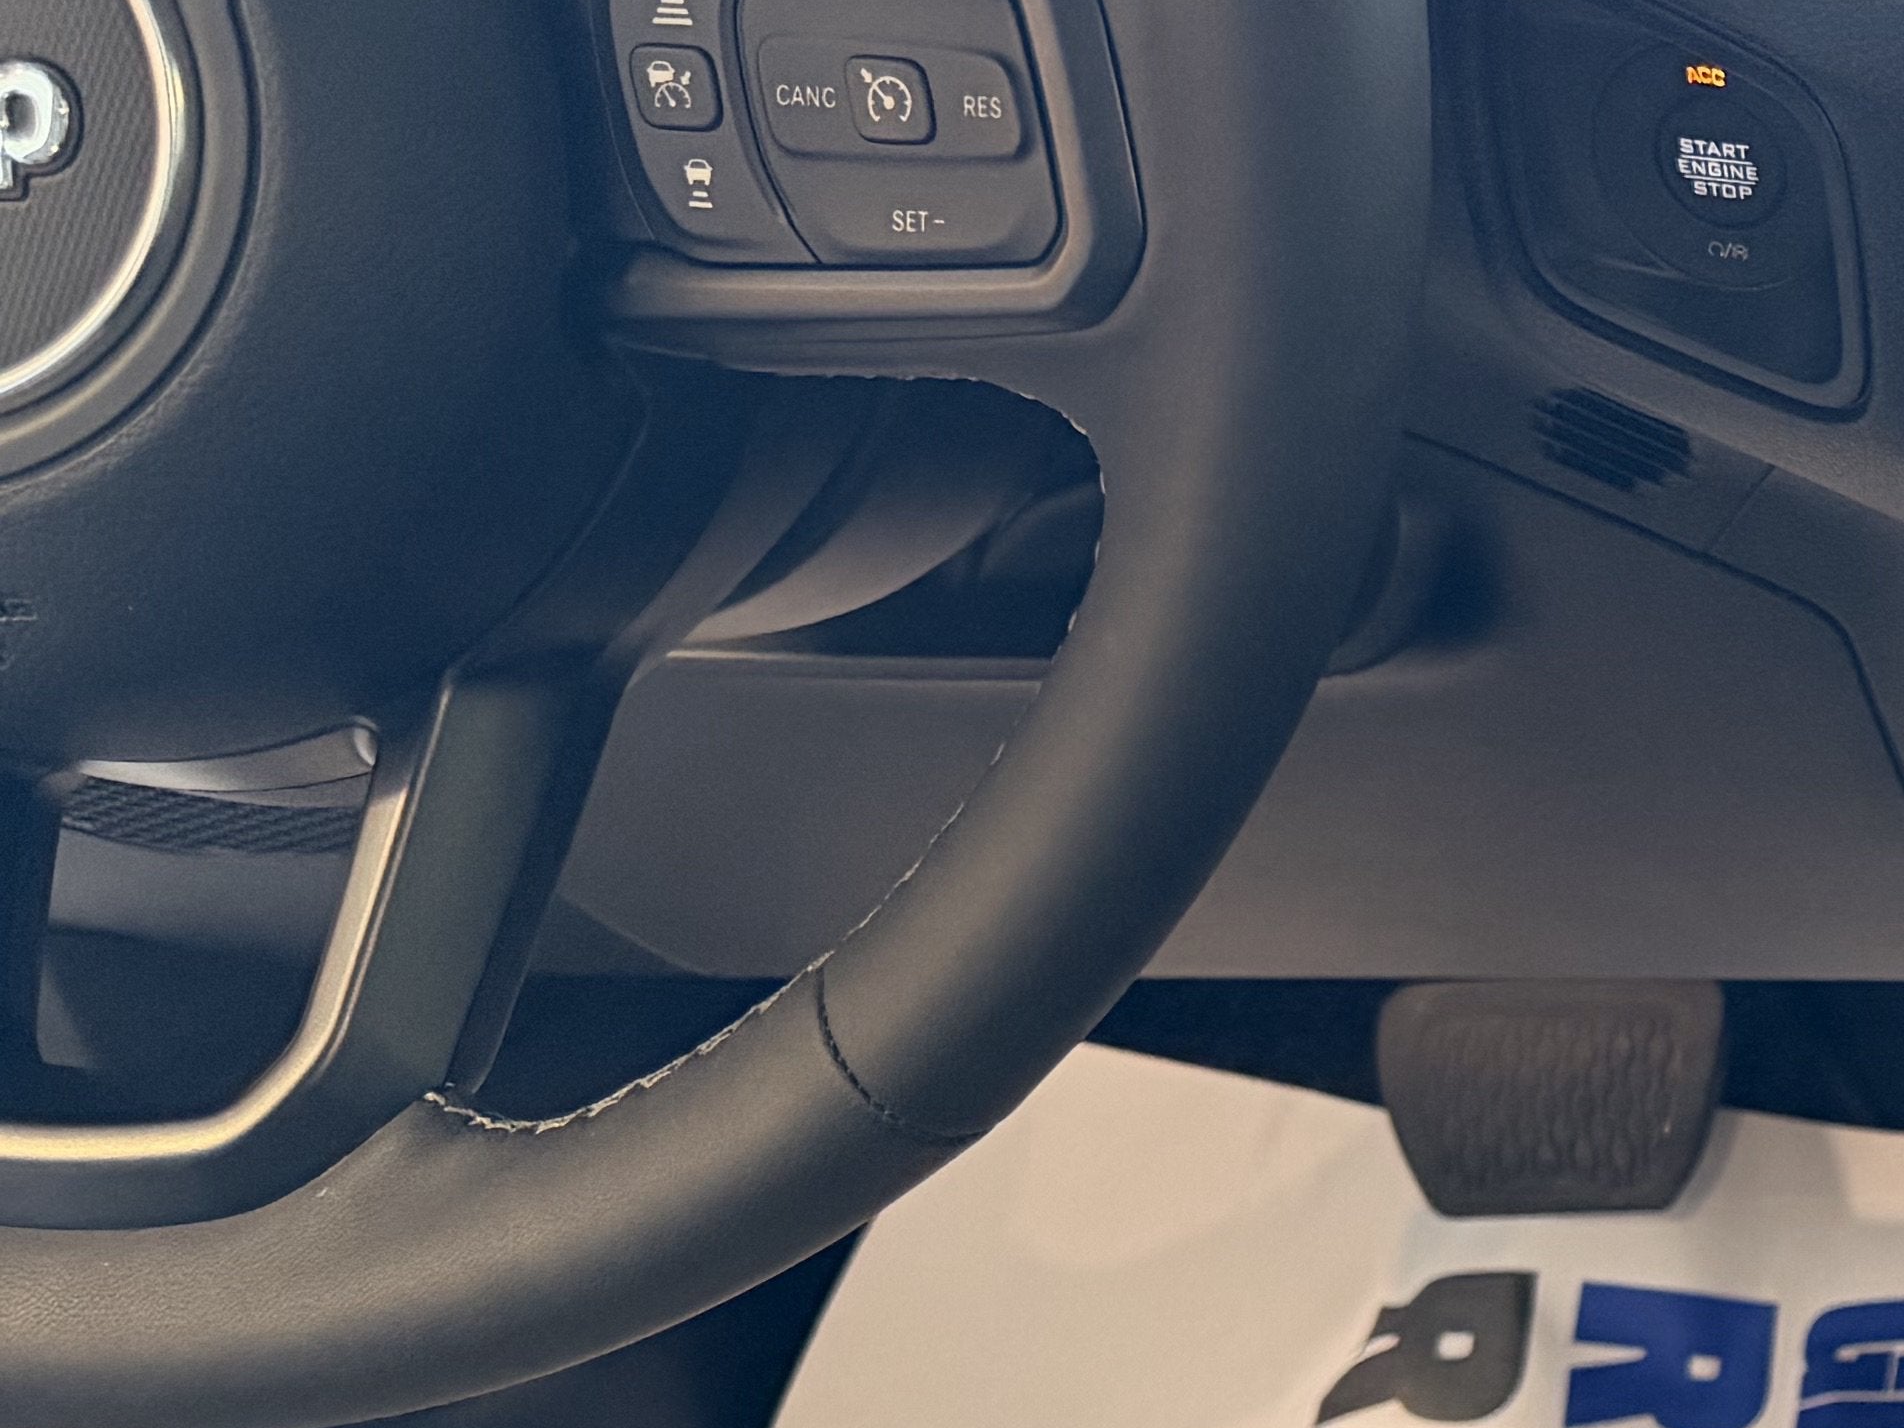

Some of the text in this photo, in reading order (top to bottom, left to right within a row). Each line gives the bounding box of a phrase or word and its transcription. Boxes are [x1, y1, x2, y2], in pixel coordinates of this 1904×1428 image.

[1685, 66, 1726, 87] ACC
[776, 84, 837, 109] CANC
[962, 96, 1002, 120] RES
[1679, 137, 1750, 159] START
[1677, 158, 1759, 181] ENGINE
[1693, 180, 1753, 200] STOP
